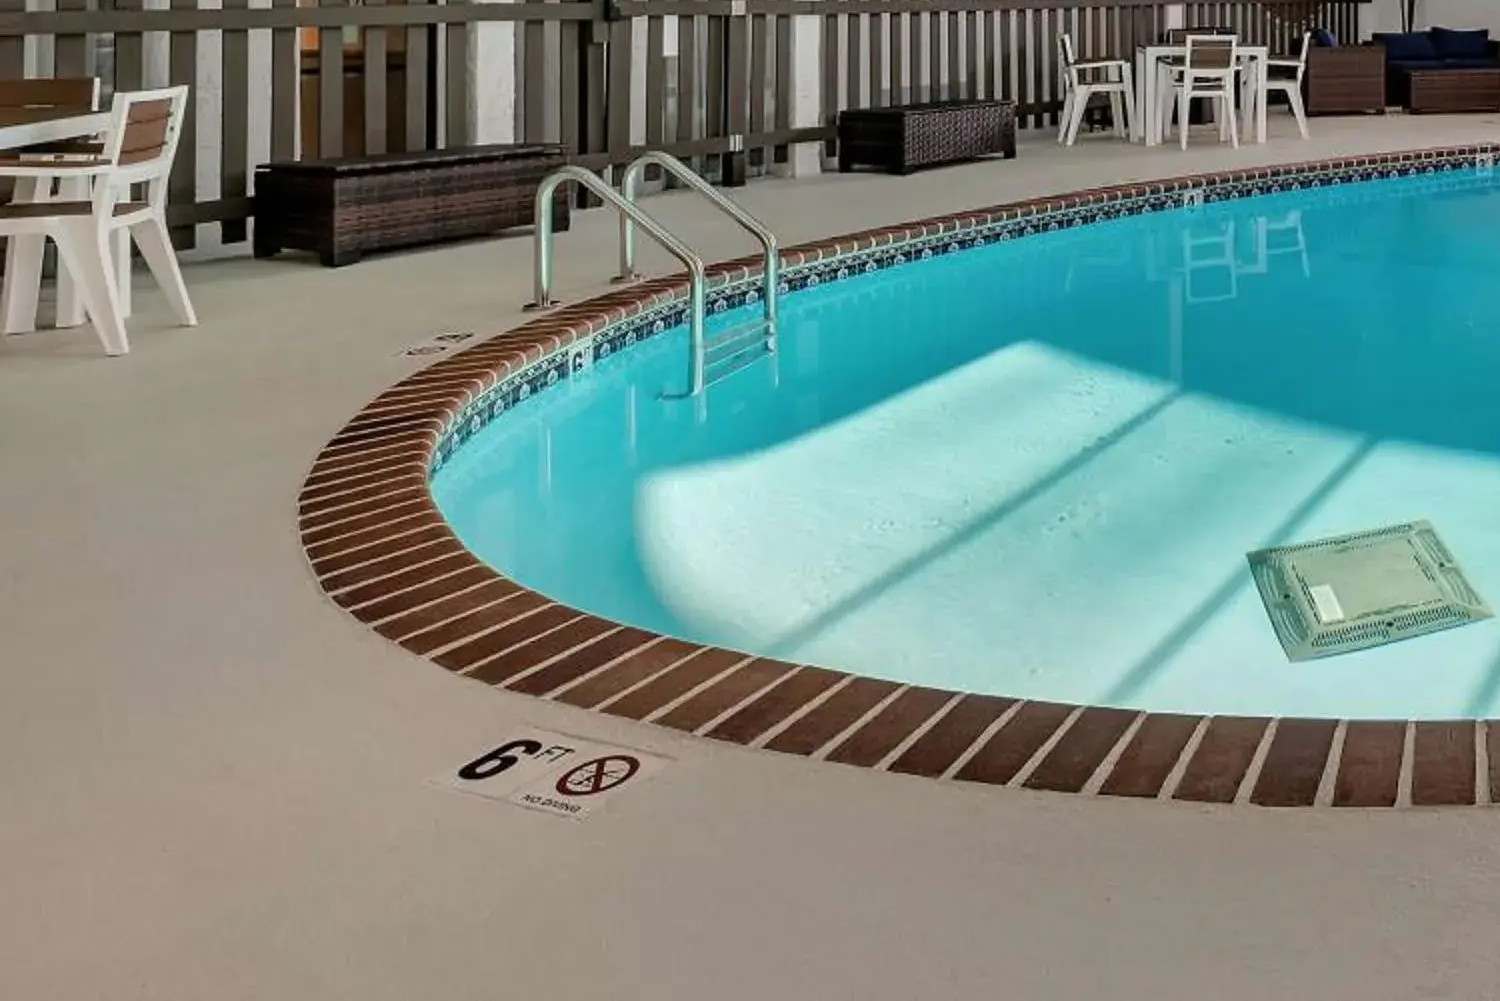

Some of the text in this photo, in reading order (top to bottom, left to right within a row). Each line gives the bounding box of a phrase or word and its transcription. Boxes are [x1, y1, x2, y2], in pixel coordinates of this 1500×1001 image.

[458, 739, 576, 781] 6 FT
[519, 793, 582, 815] NO DIVING
